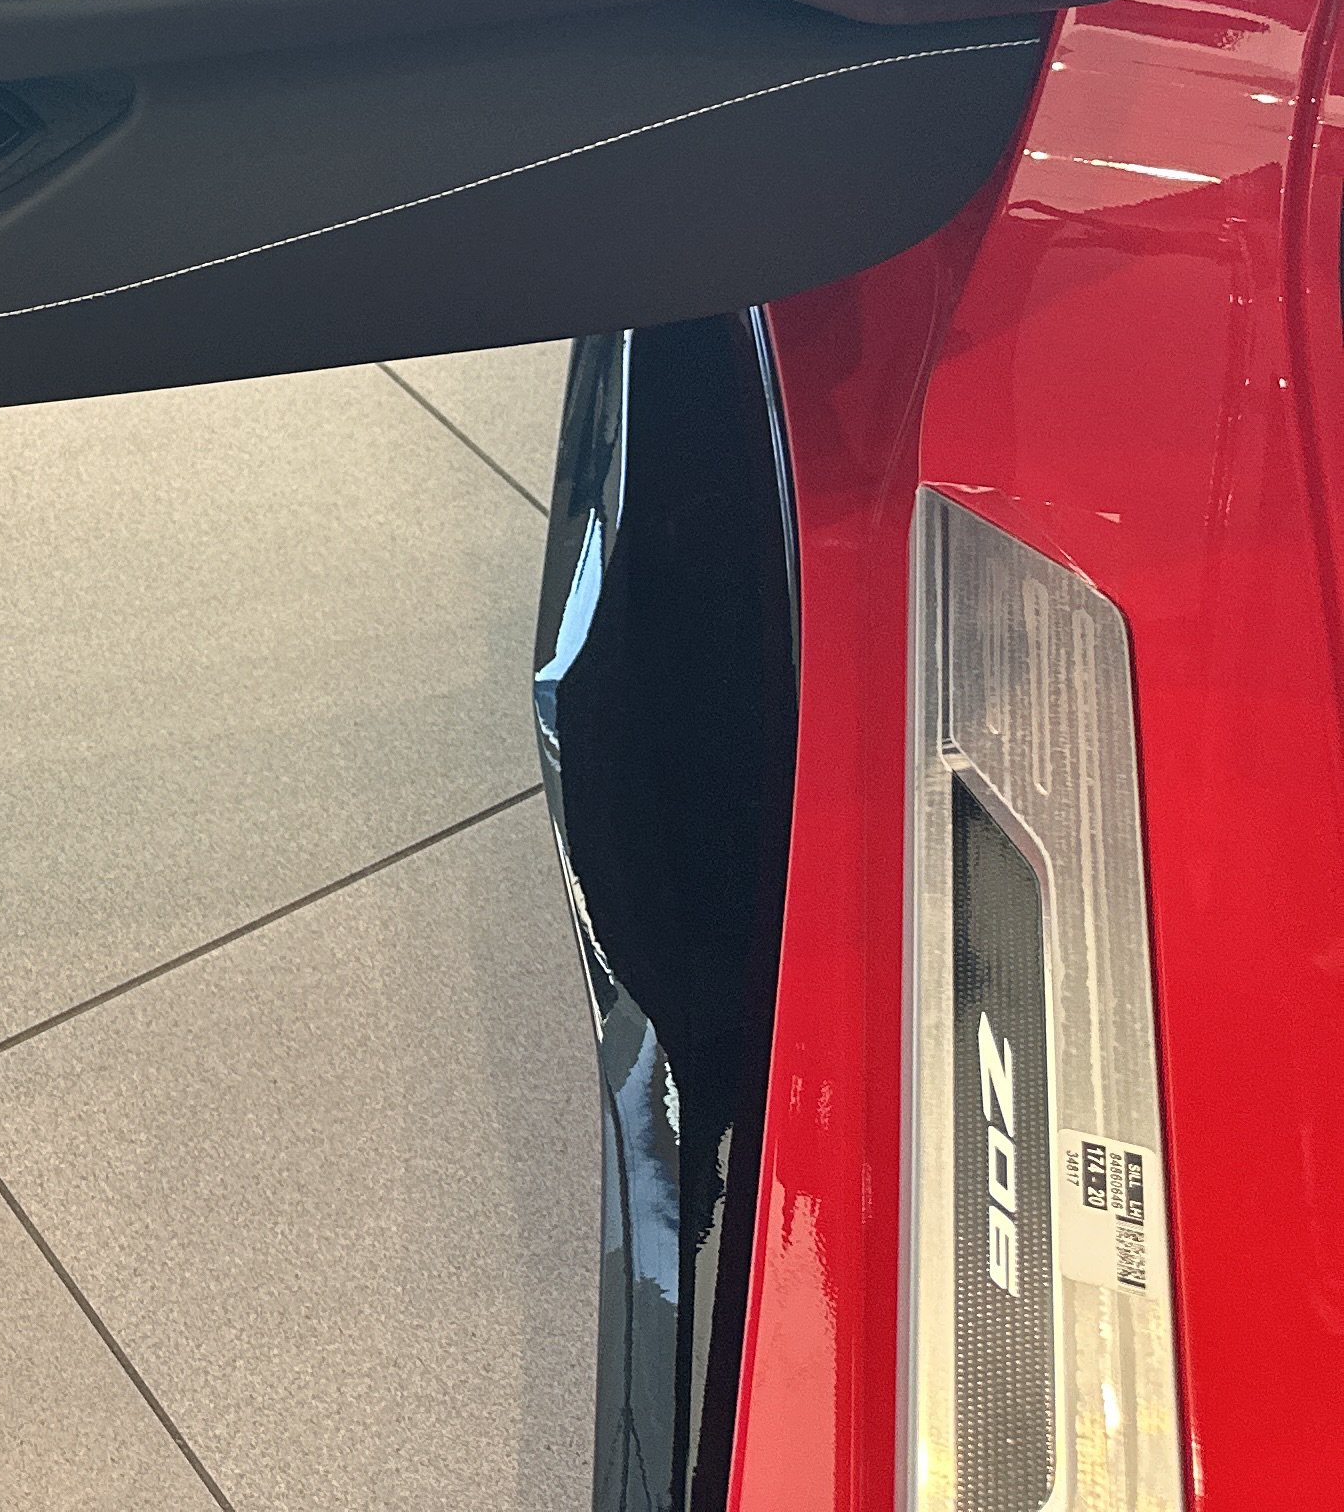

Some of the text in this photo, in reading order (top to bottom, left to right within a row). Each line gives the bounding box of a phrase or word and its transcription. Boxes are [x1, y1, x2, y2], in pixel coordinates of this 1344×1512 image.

[978, 1011, 1020, 1298] Z06
[1066, 1150, 1080, 1186] 34817
[1086, 1147, 1105, 1174] 174
[1087, 1186, 1105, 1207] 20
[1128, 1163, 1143, 1217] SILL LH
